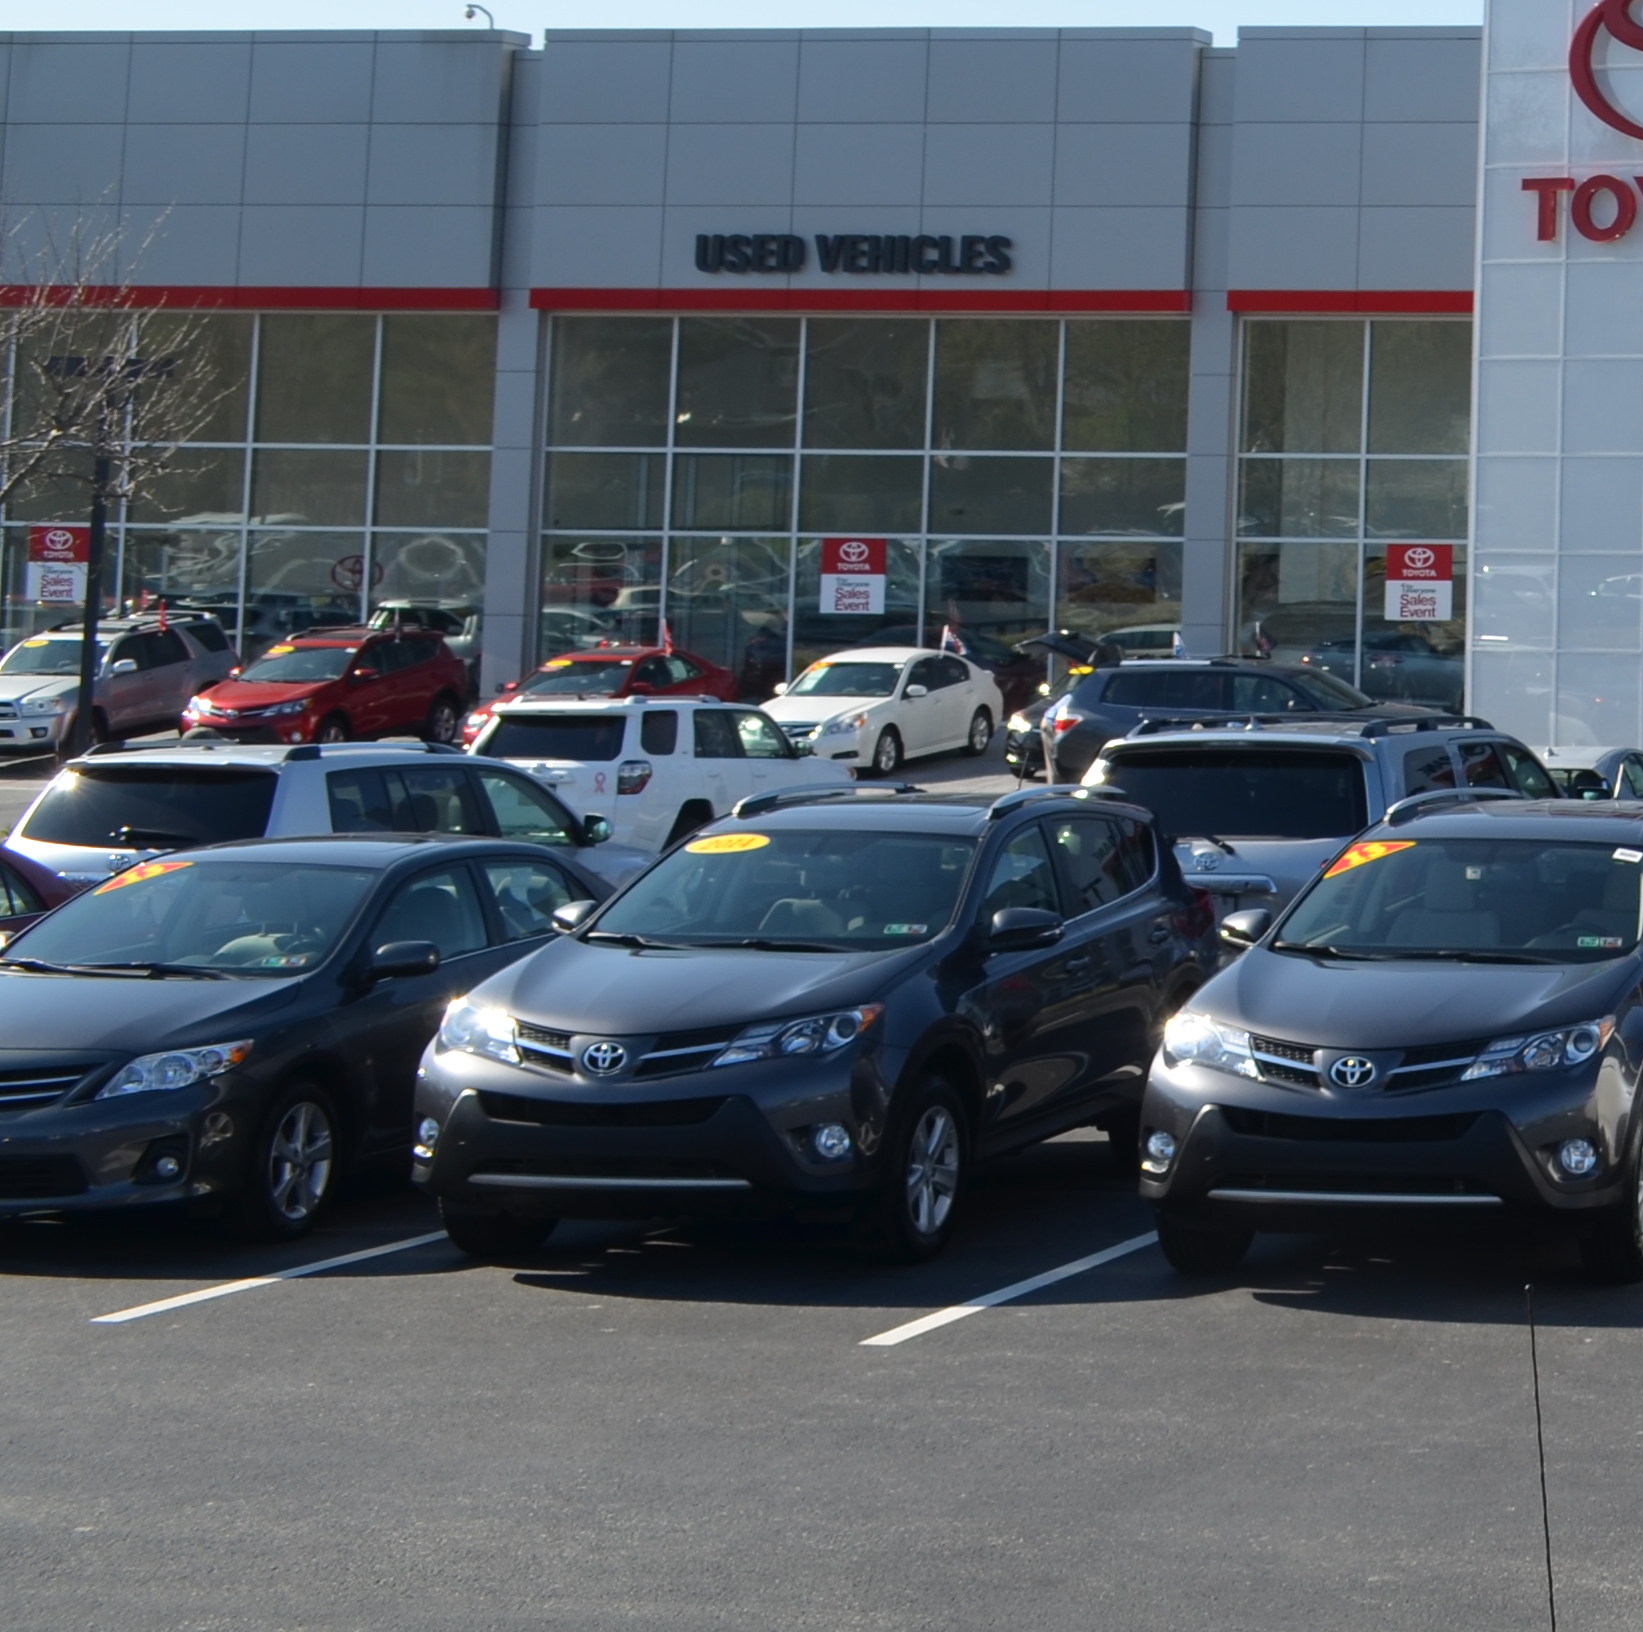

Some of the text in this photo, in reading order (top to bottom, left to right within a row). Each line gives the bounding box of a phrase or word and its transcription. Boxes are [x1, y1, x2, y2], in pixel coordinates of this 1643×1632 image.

[695, 234, 1013, 275] USED VEHICLES
[836, 562, 871, 571] TOYOTA
[1402, 569, 1437, 577] TOYOTA
[835, 588, 870, 599] Sales
[834, 599, 870, 611] Event
[1400, 594, 1436, 606] Sales
[1400, 606, 1436, 618] Event
